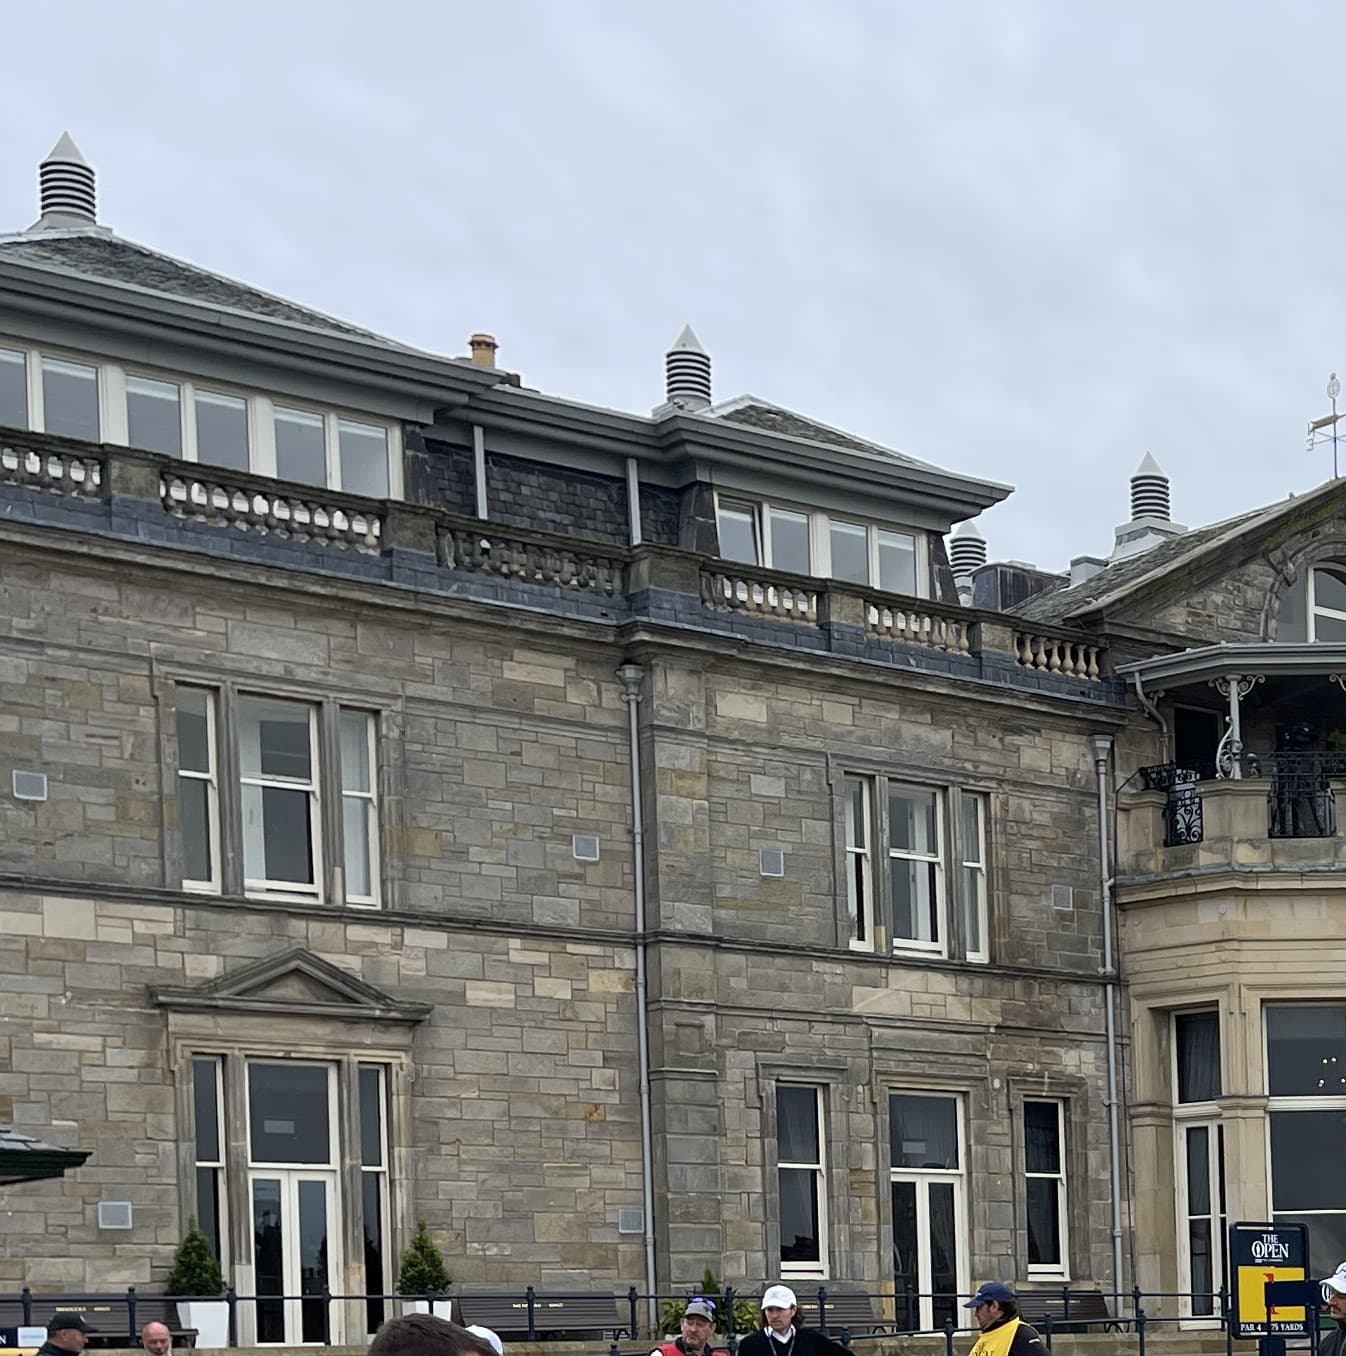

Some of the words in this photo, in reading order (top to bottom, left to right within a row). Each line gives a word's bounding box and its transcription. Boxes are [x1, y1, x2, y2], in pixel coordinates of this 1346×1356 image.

[1261, 1234, 1279, 1244] THE
[1251, 1240, 1289, 1258] OPEN
[1240, 1323, 1255, 1332] PAR
[1257, 1323, 1262, 1332] 4
[1280, 1323, 1304, 1332] YARDS
